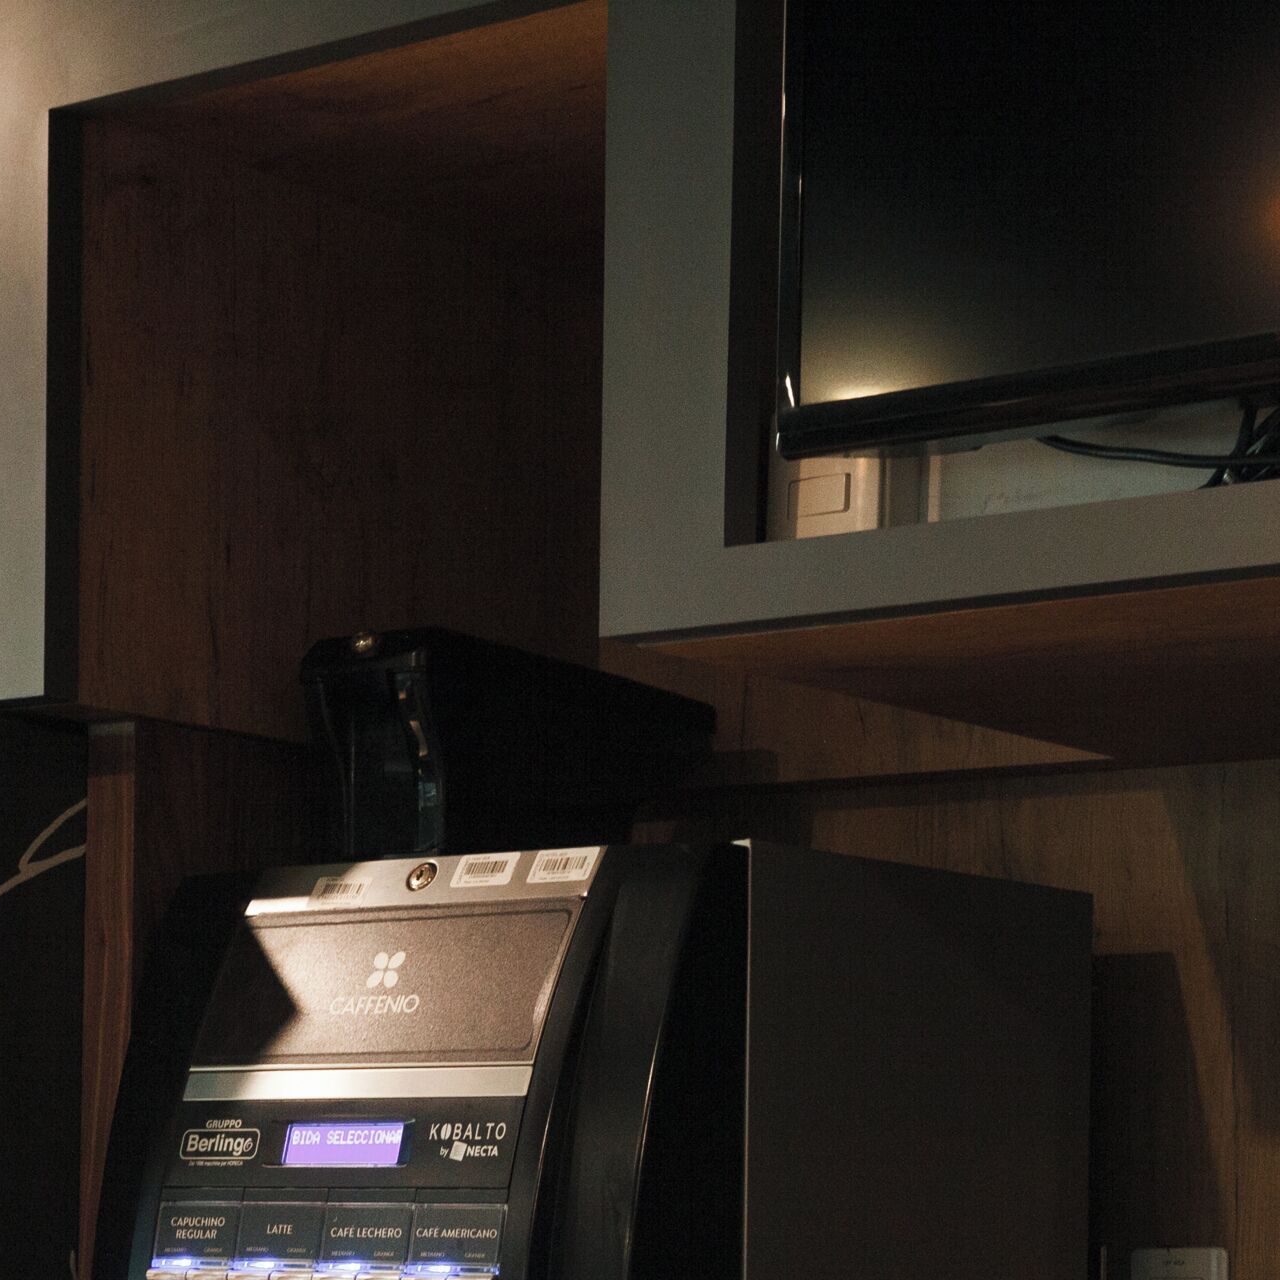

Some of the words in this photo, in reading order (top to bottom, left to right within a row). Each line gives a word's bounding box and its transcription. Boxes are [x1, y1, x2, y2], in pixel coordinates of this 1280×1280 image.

[329, 994, 420, 1016] CAFFENIO
[206, 1119, 242, 1129] GRUPPO
[428, 1122, 507, 1141] KOBALTO
[186, 1133, 254, 1156] Berlingo
[292, 1129, 320, 1145] BIDA
[326, 1129, 402, 1145] SELECCIONAR
[439, 1146, 449, 1157] by
[466, 1145, 498, 1157] NECTA
[170, 1216, 226, 1227] CAPUCHINO
[266, 1223, 293, 1235] LATTE
[176, 1229, 218, 1240] REGULAR
[330, 1224, 355, 1238] CAFÉ
[356, 1227, 403, 1239] LECHERO
[416, 1225, 440, 1238] CAFÉ
[440, 1228, 498, 1240] AMERICANO
